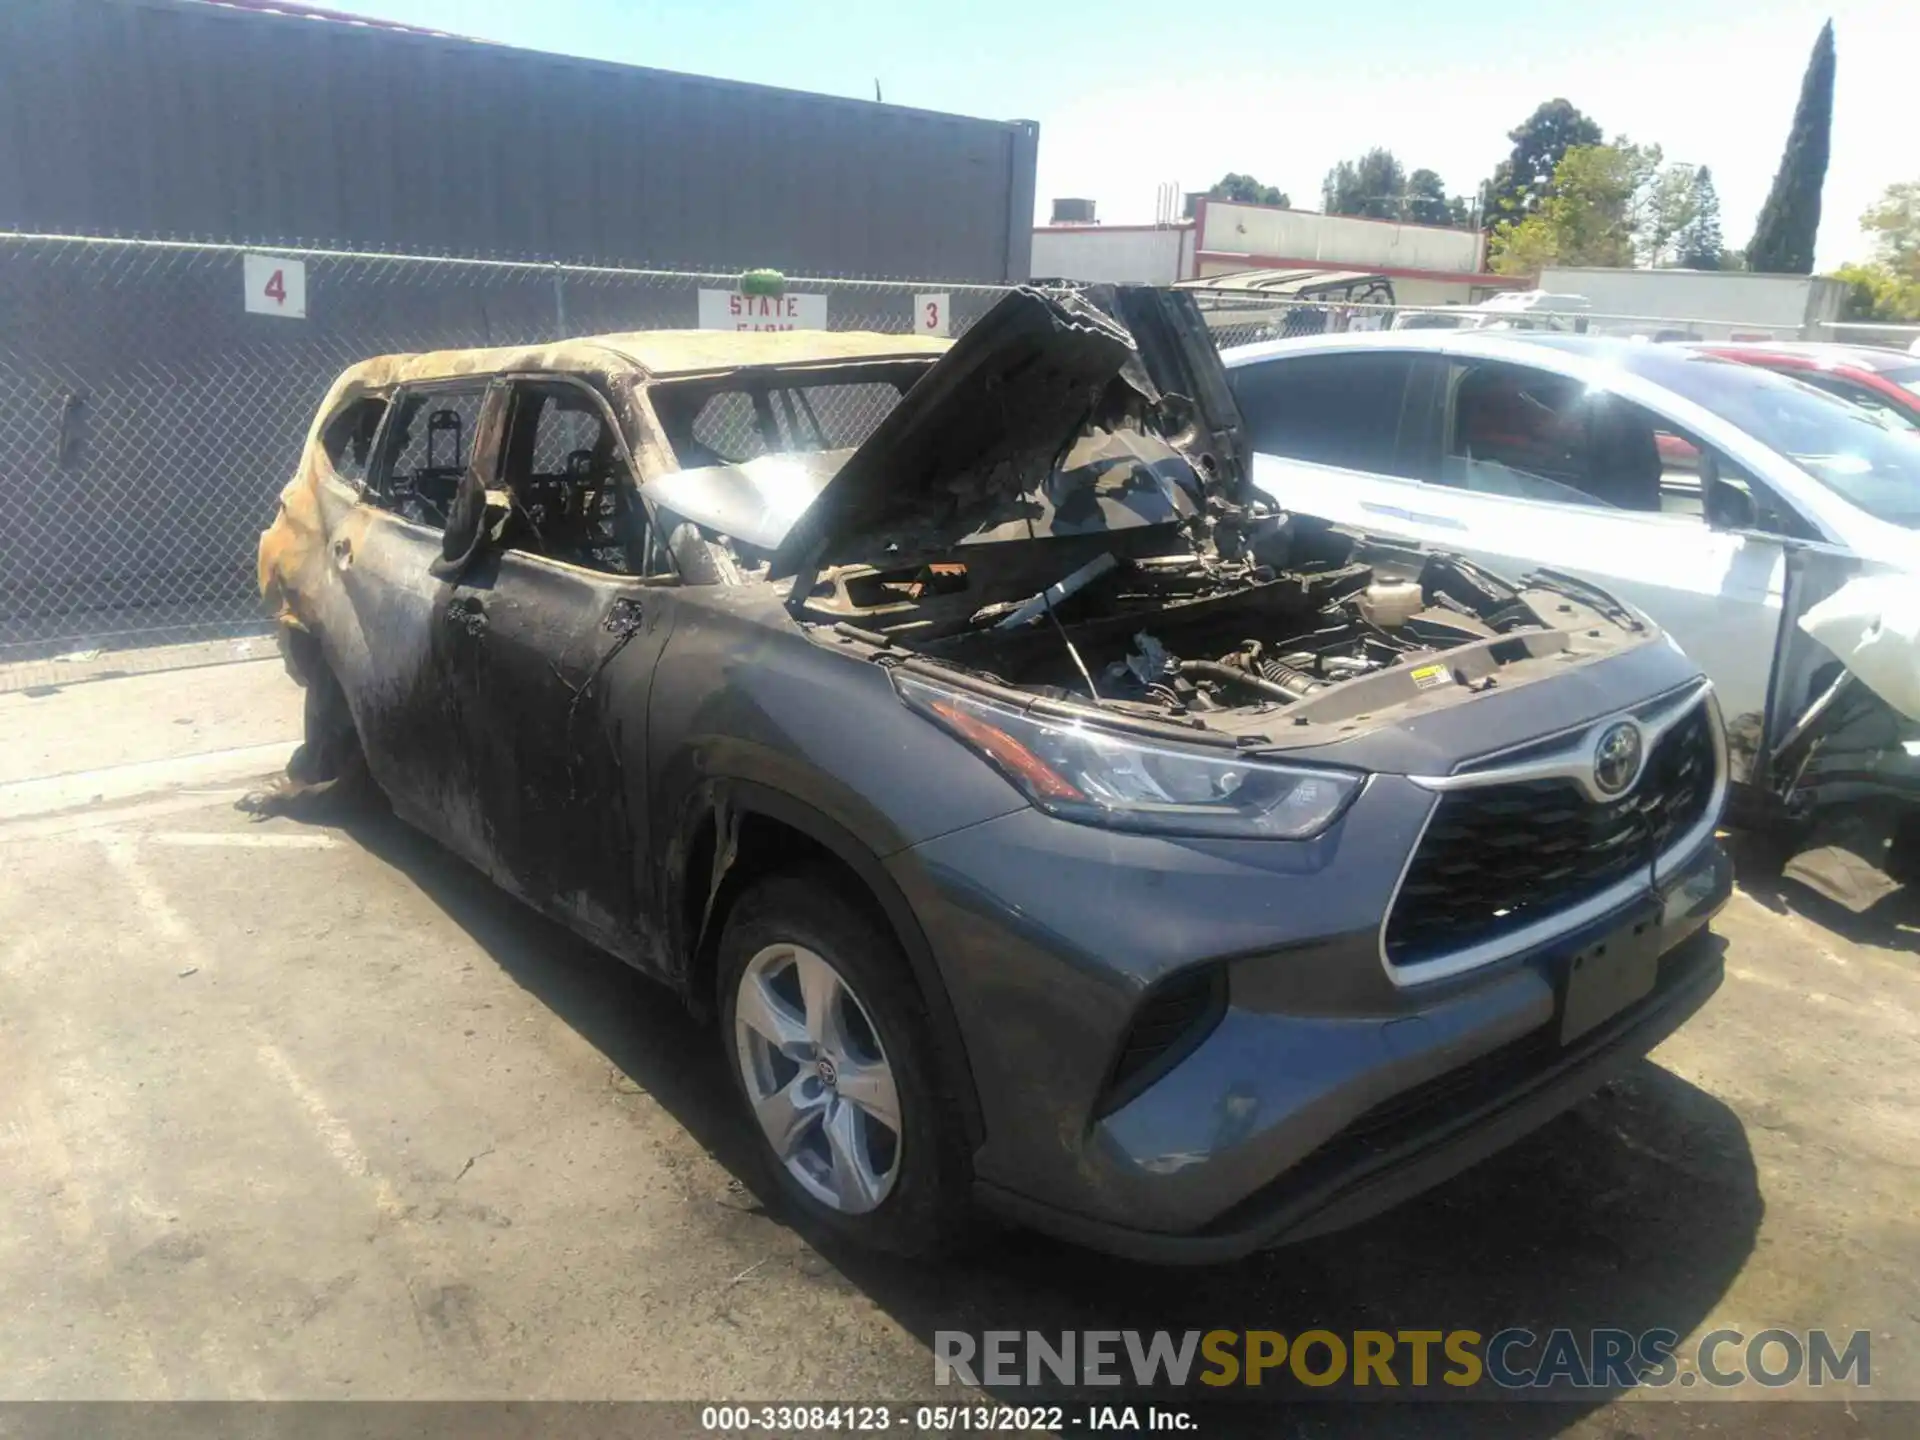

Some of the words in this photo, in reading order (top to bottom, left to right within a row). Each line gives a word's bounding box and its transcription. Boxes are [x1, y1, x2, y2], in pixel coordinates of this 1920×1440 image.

[264, 269, 287, 306] 4
[729, 295, 799, 317] STATE
[926, 302, 938, 329] 3
